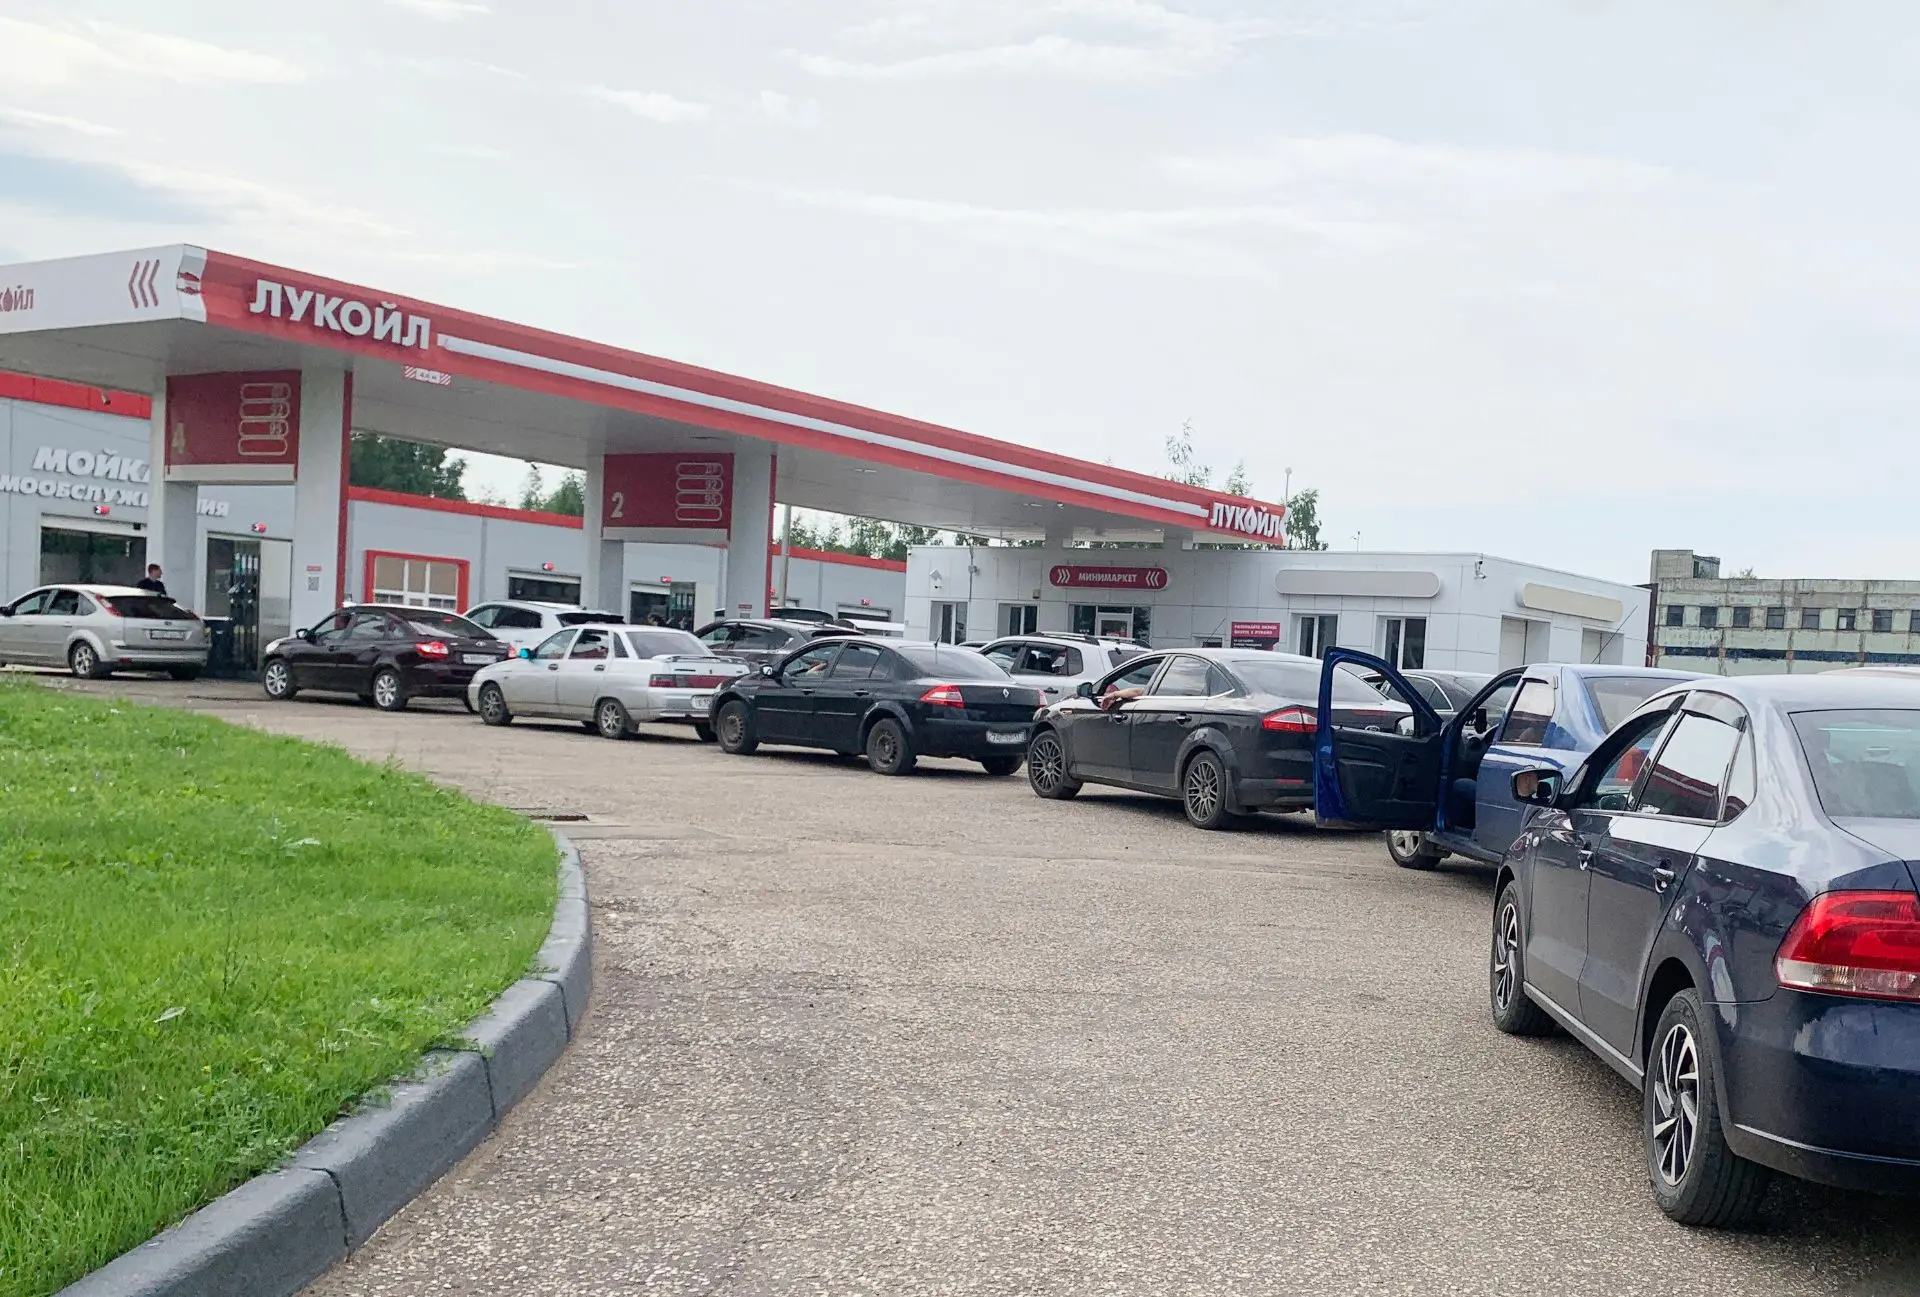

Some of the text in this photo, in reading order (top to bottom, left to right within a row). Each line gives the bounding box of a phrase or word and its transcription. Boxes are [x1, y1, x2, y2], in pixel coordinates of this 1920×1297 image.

[250, 279, 430, 349] ЛУКОЙЛ
[611, 491, 624, 518] 2
[1210, 502, 1281, 538] ЛУКОЙЛ
[1078, 572, 1137, 583] МИНИМАРКЕТ
